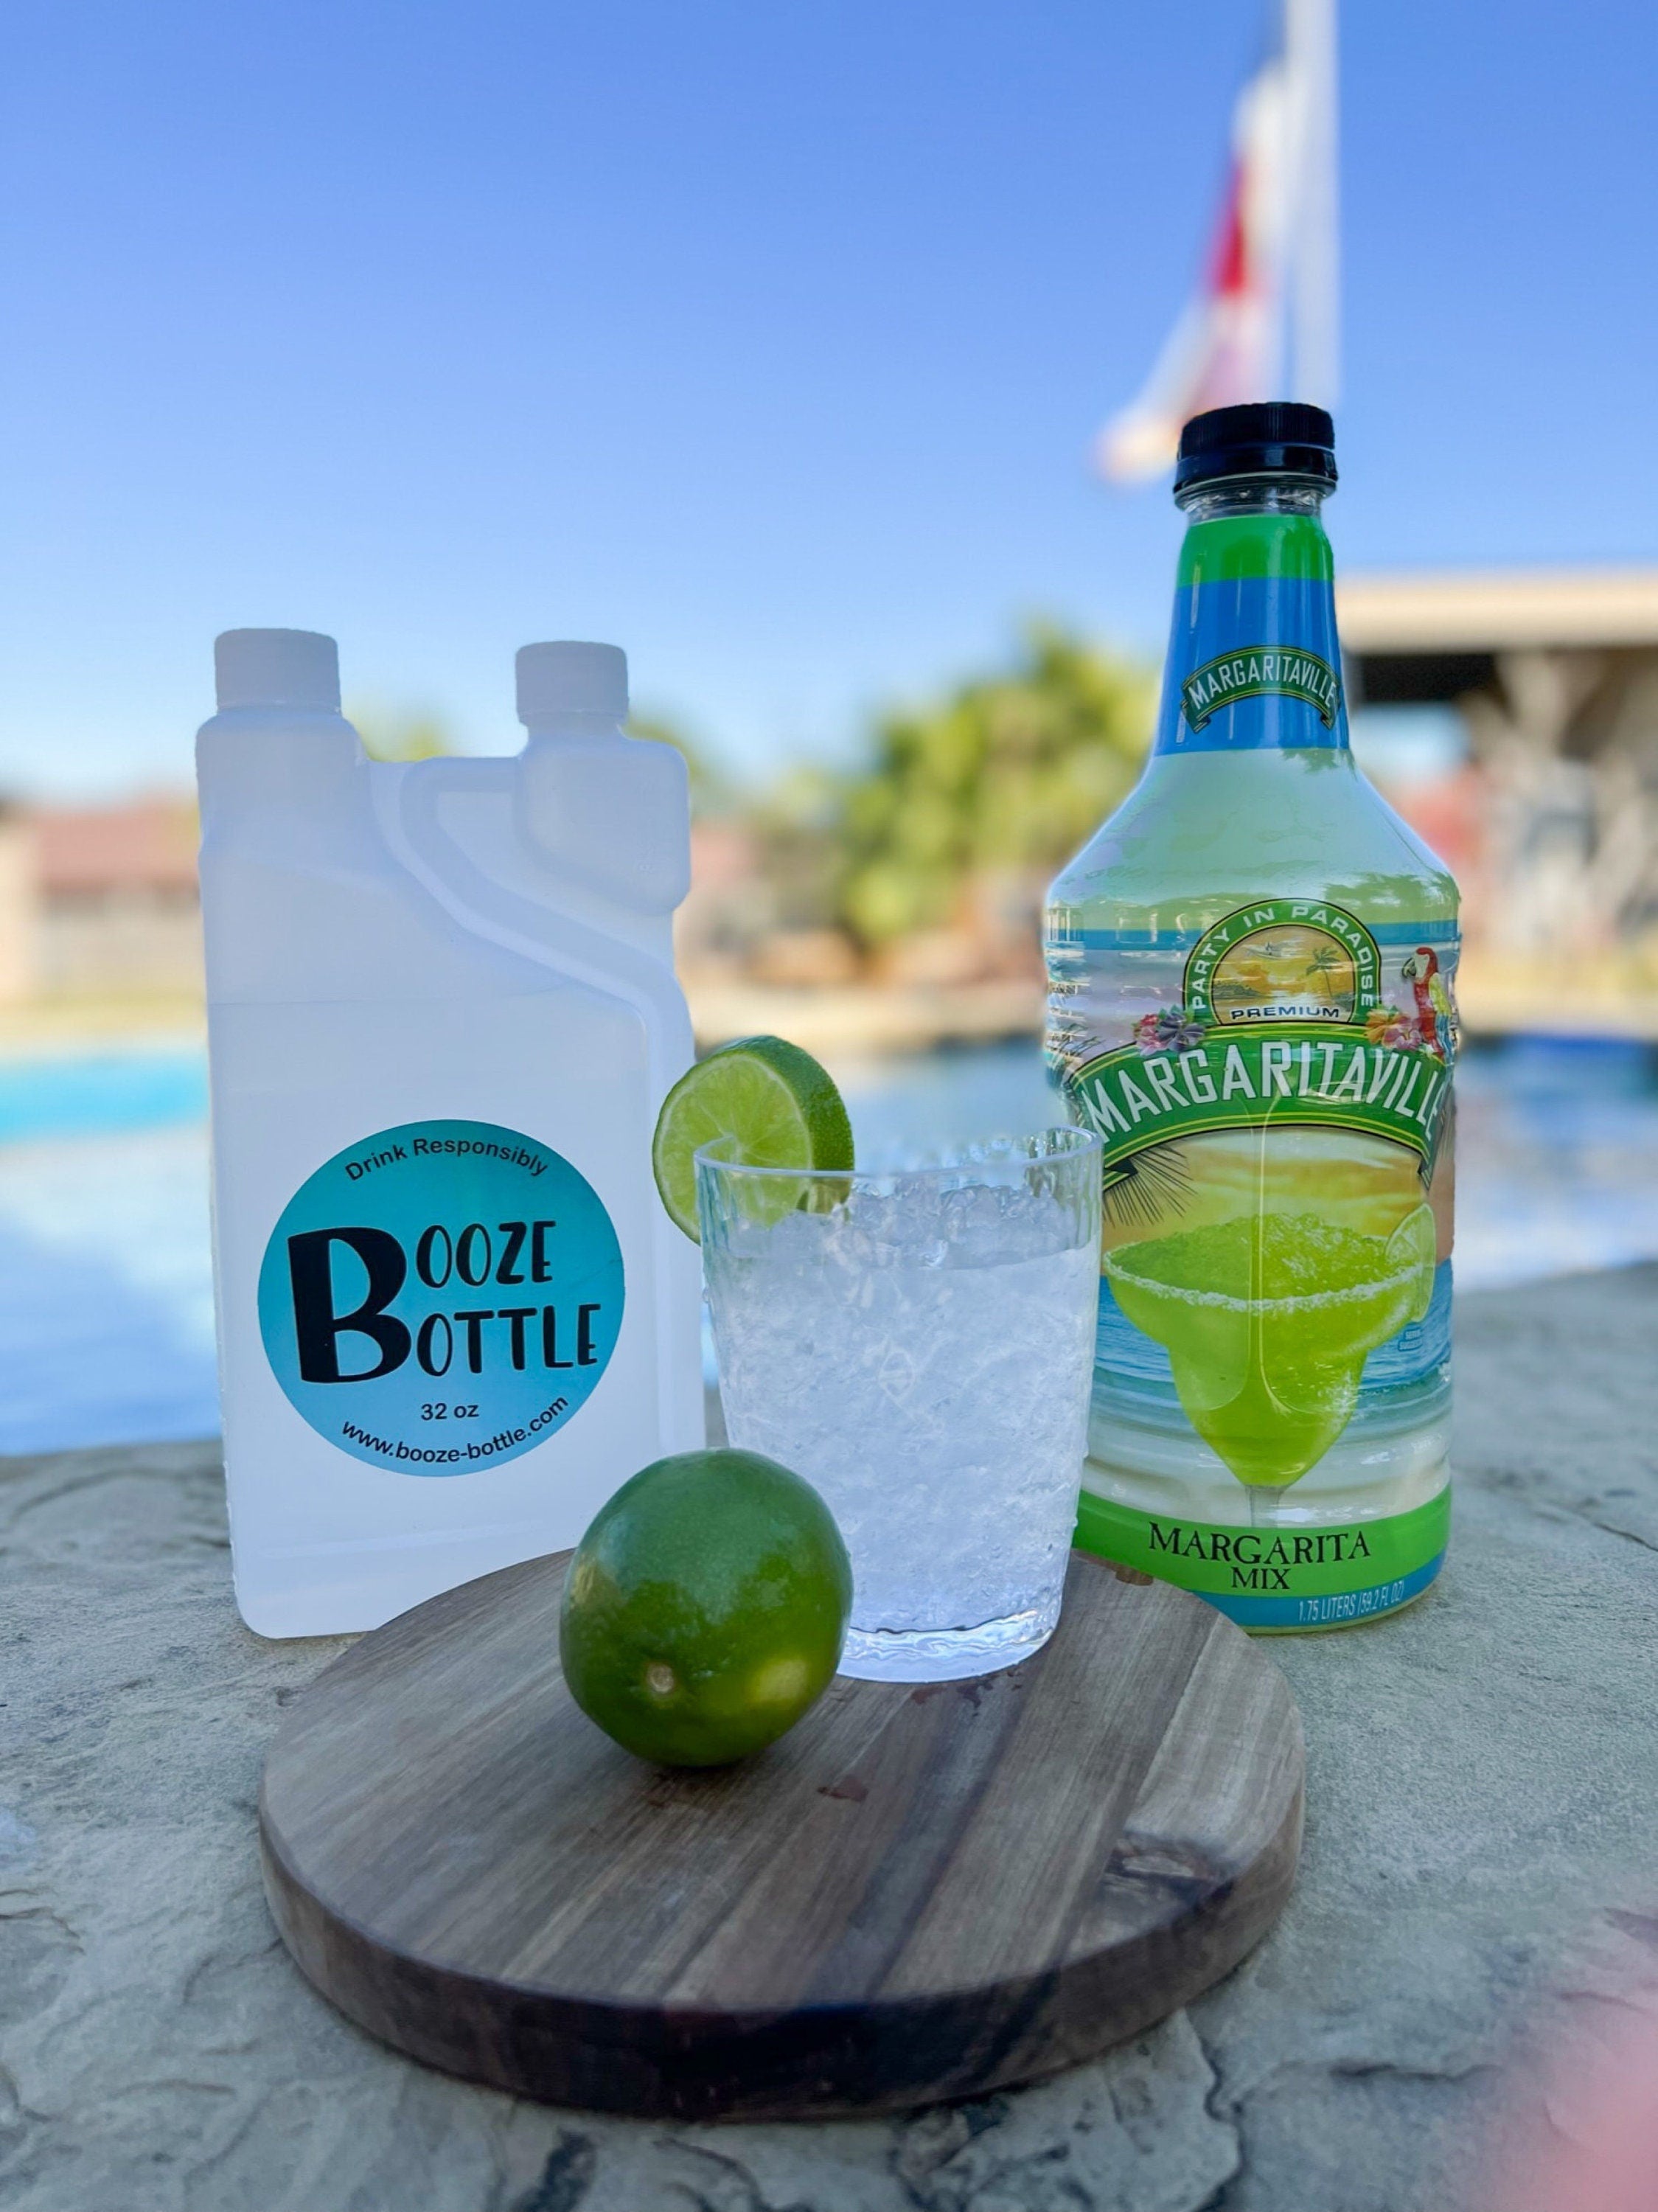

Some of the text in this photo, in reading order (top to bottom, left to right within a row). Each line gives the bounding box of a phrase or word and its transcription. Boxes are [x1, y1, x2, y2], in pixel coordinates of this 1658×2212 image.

[1188, 655, 1337, 709] MARGARITAVILLE
[1191, 905, 1374, 1009] PARTY IN PARADISE
[1230, 1006, 1340, 1020] PREMIUM
[345, 1138, 548, 1180] Drink Responsibly
[341, 1397, 569, 1464] www.booze-bottle.com
[420, 1403, 479, 1421] 32 oz
[1149, 1521, 1371, 1565] MARGARITA
[1231, 1567, 1290, 1590] MIX
[1299, 1599, 1320, 1621] 1.75
[1321, 1593, 1356, 1620] LITERS
[1379, 1585, 1389, 1607] FL
